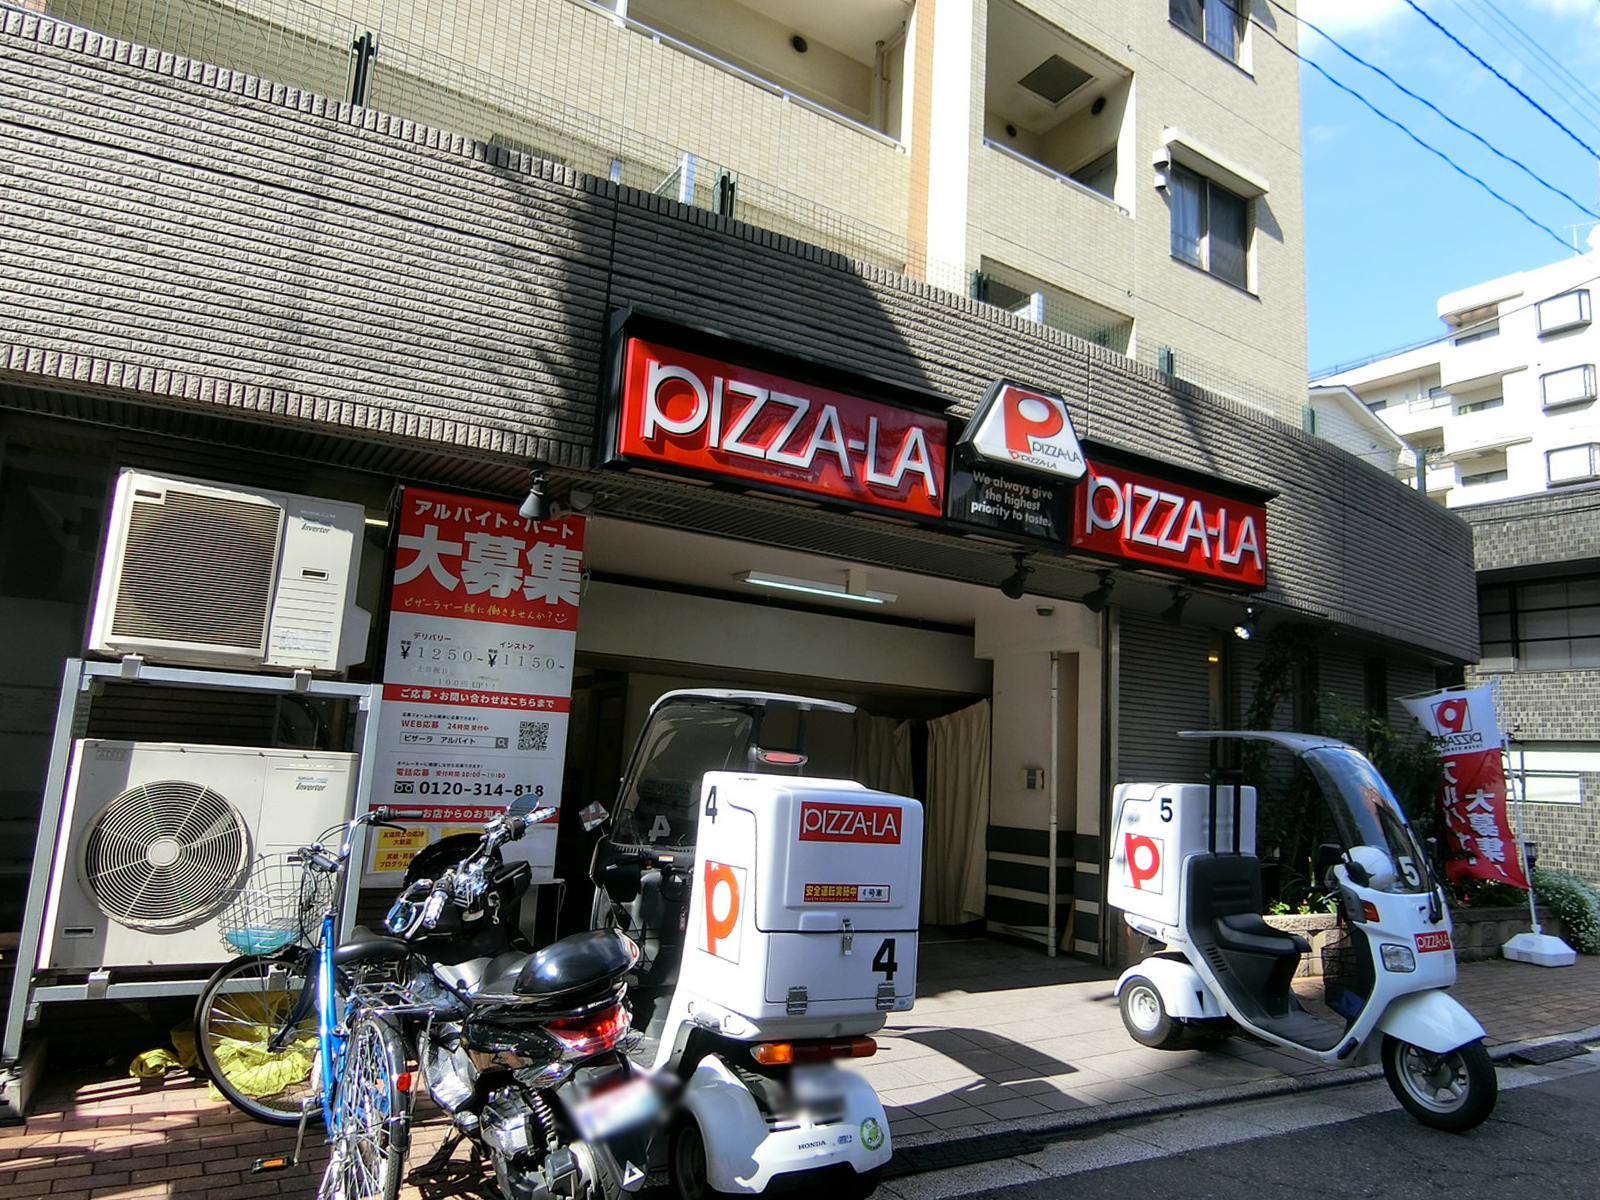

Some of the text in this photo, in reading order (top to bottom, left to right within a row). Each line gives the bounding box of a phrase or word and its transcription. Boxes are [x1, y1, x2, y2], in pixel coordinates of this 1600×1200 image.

[973, 470, 1054, 501] We always give
[985, 487, 1042, 512] the highest
[970, 501, 1053, 528] priority to taste.
[301, 523, 331, 535] Inverter
[394, 524, 584, 607] 大募集
[413, 631, 452, 642] デリバリー
[500, 641, 535, 651] インストア
[400, 688, 556, 709] ご応募・お問い合わせはこちらまで
[401, 719, 439, 729] WEB応募
[404, 734, 476, 745] ピザーラ アルバイト
[396, 768, 430, 777] 電話応募
[296, 782, 327, 791] Inverter
[419, 781, 544, 797] 0120-314-818
[705, 785, 718, 825] 4
[1160, 797, 1173, 823] 5
[1398, 856, 1421, 887] 5
[872, 938, 898, 981] 4
[797, 1140, 827, 1150] HONDA
